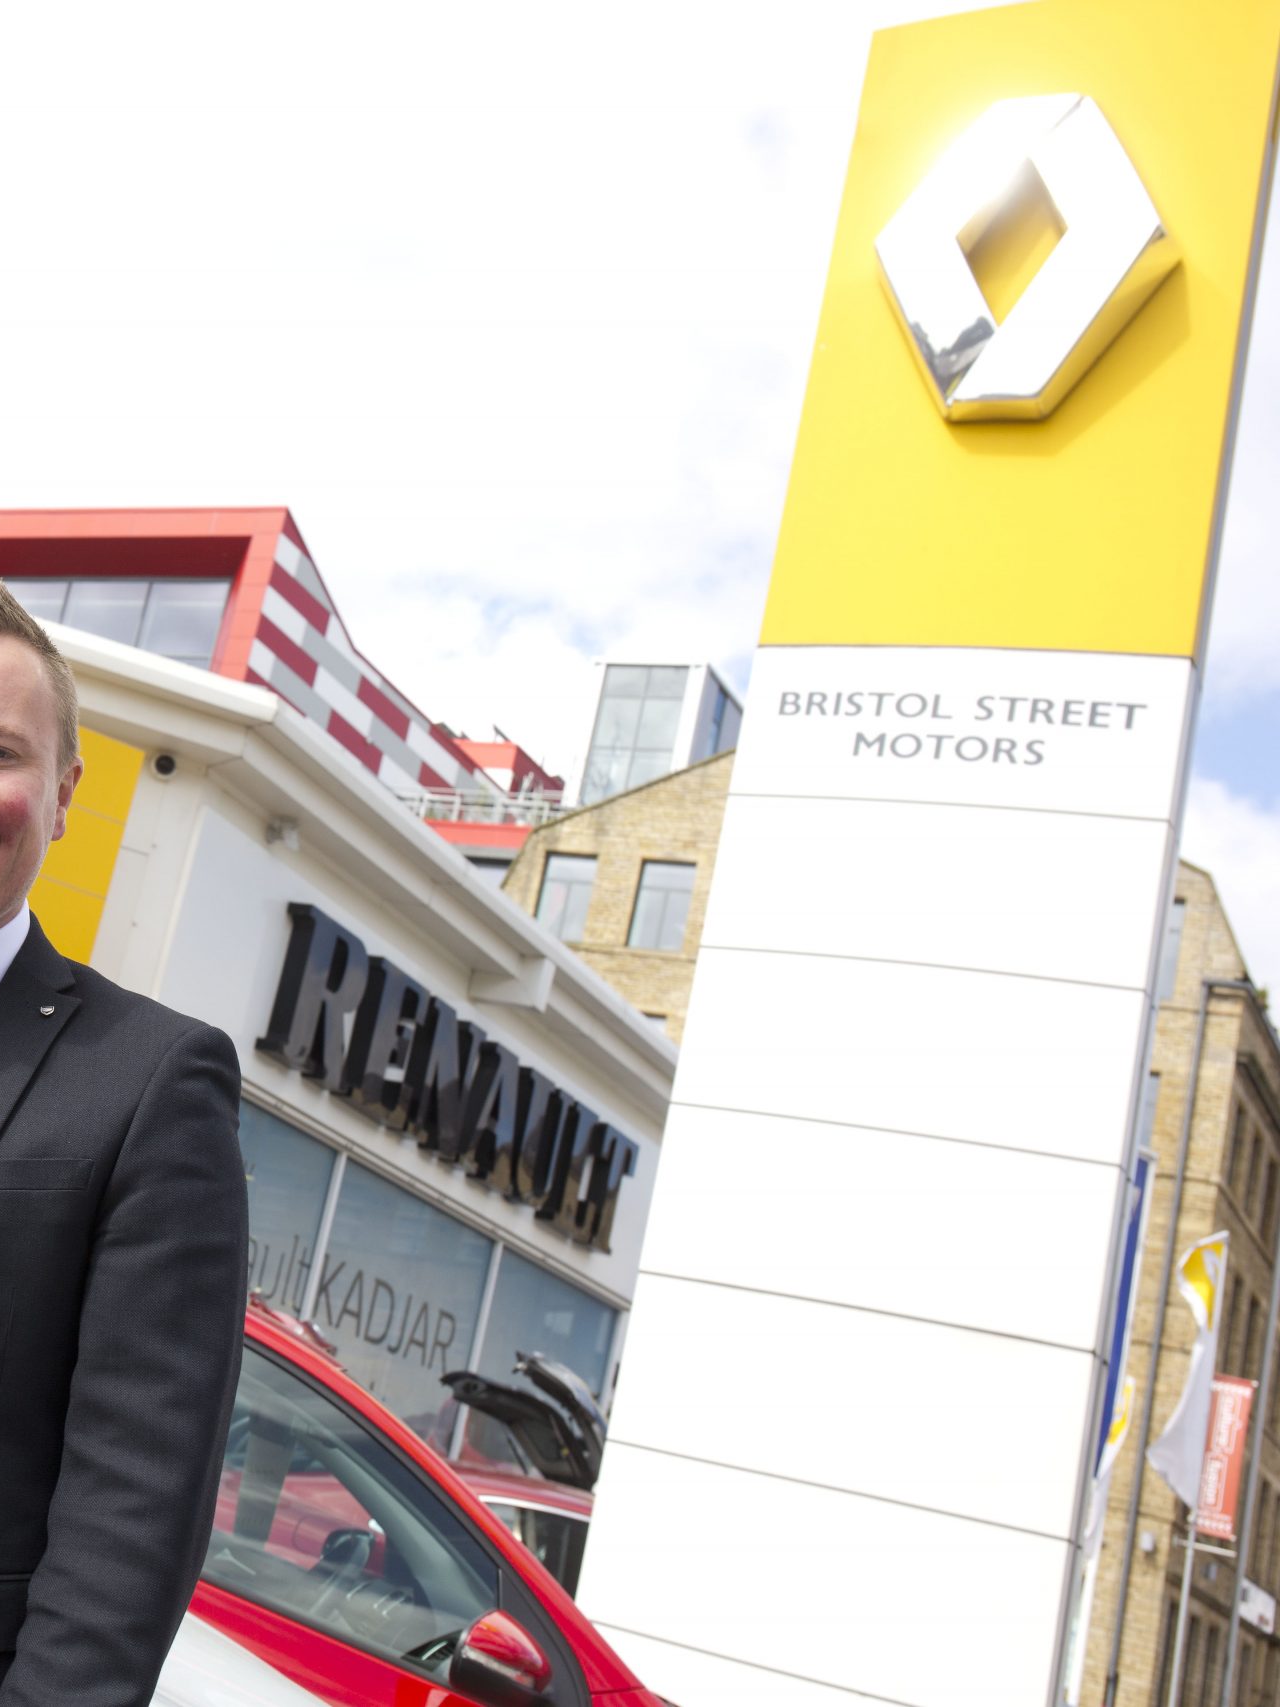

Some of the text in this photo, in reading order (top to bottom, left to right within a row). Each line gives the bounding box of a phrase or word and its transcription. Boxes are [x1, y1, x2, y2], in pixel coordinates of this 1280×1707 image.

[778, 691, 1148, 730] BRISTOL STREET
[852, 731, 1045, 766] MOTORS
[254, 901, 640, 1255] RENAULT
[312, 1253, 457, 1374] KADJAR
